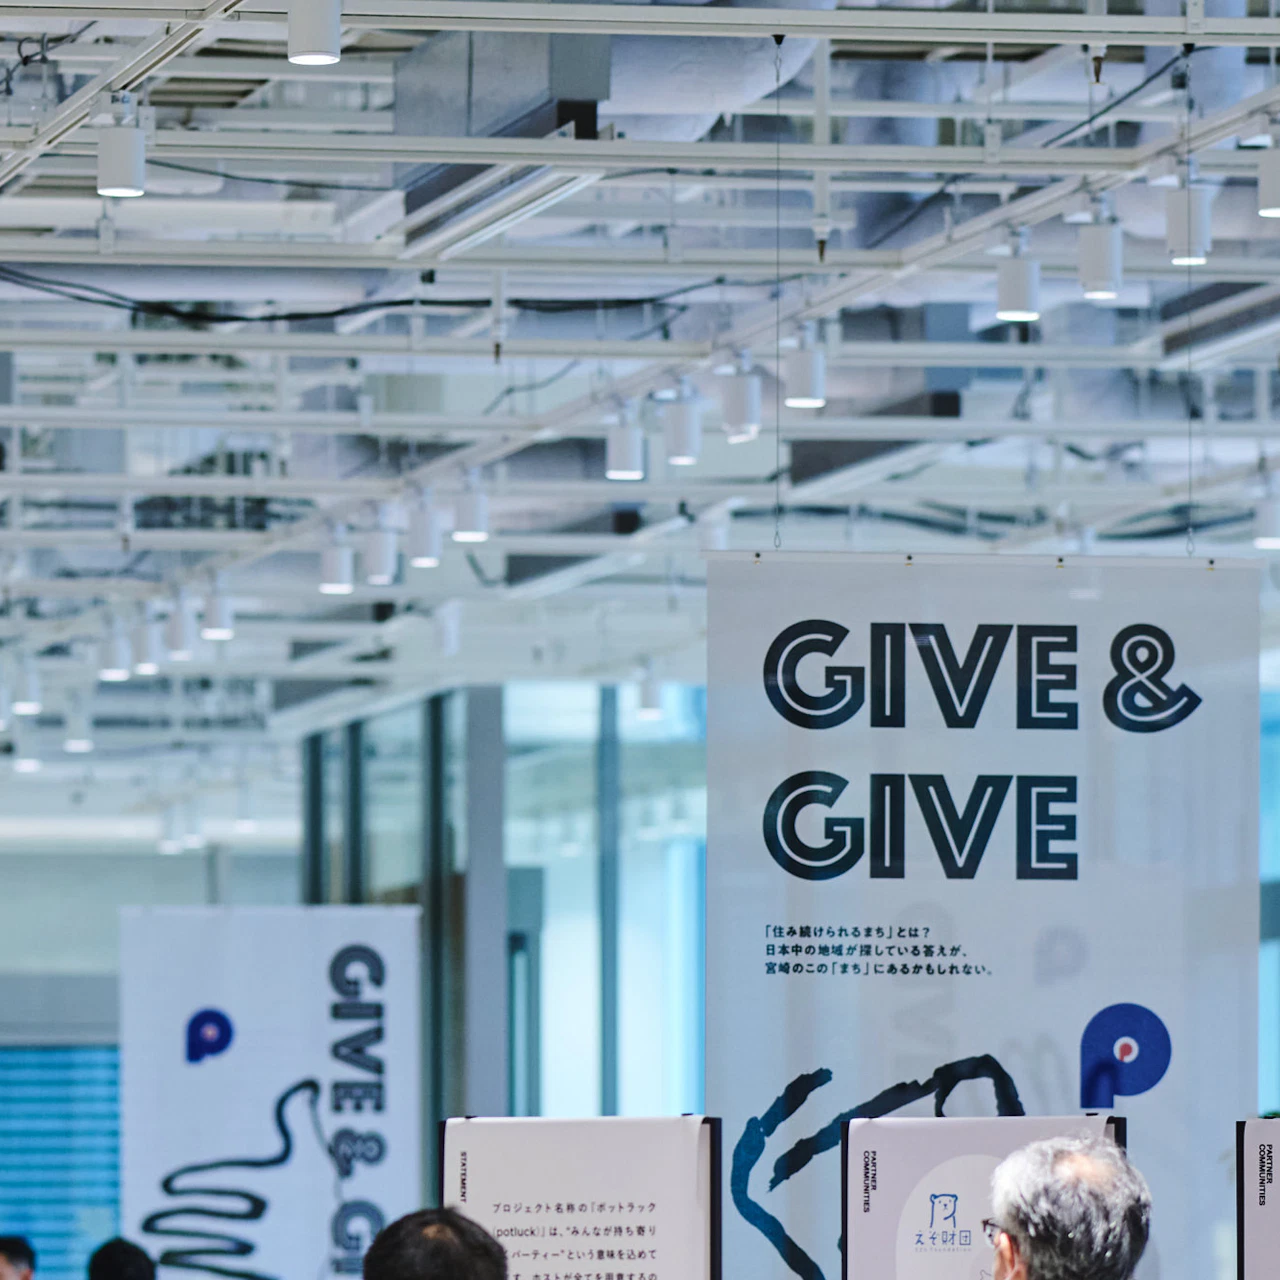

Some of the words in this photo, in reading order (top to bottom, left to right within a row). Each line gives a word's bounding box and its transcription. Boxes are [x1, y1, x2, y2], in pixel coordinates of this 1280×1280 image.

[763, 619, 1078, 730] GIVE
[1102, 623, 1202, 733] &
[763, 770, 1078, 881] GIVE
[765, 943, 968, 958] 日本中の地域が探している答えが、
[765, 961, 993, 976] 宮崎のこの「まち」にあるかもしれない。
[328, 943, 387, 1115] GIVE
[330, 1129, 388, 1179] &
[459, 1151, 468, 1203] STATEMENT
[1258, 1144, 1266, 1206] COMMUNITIES
